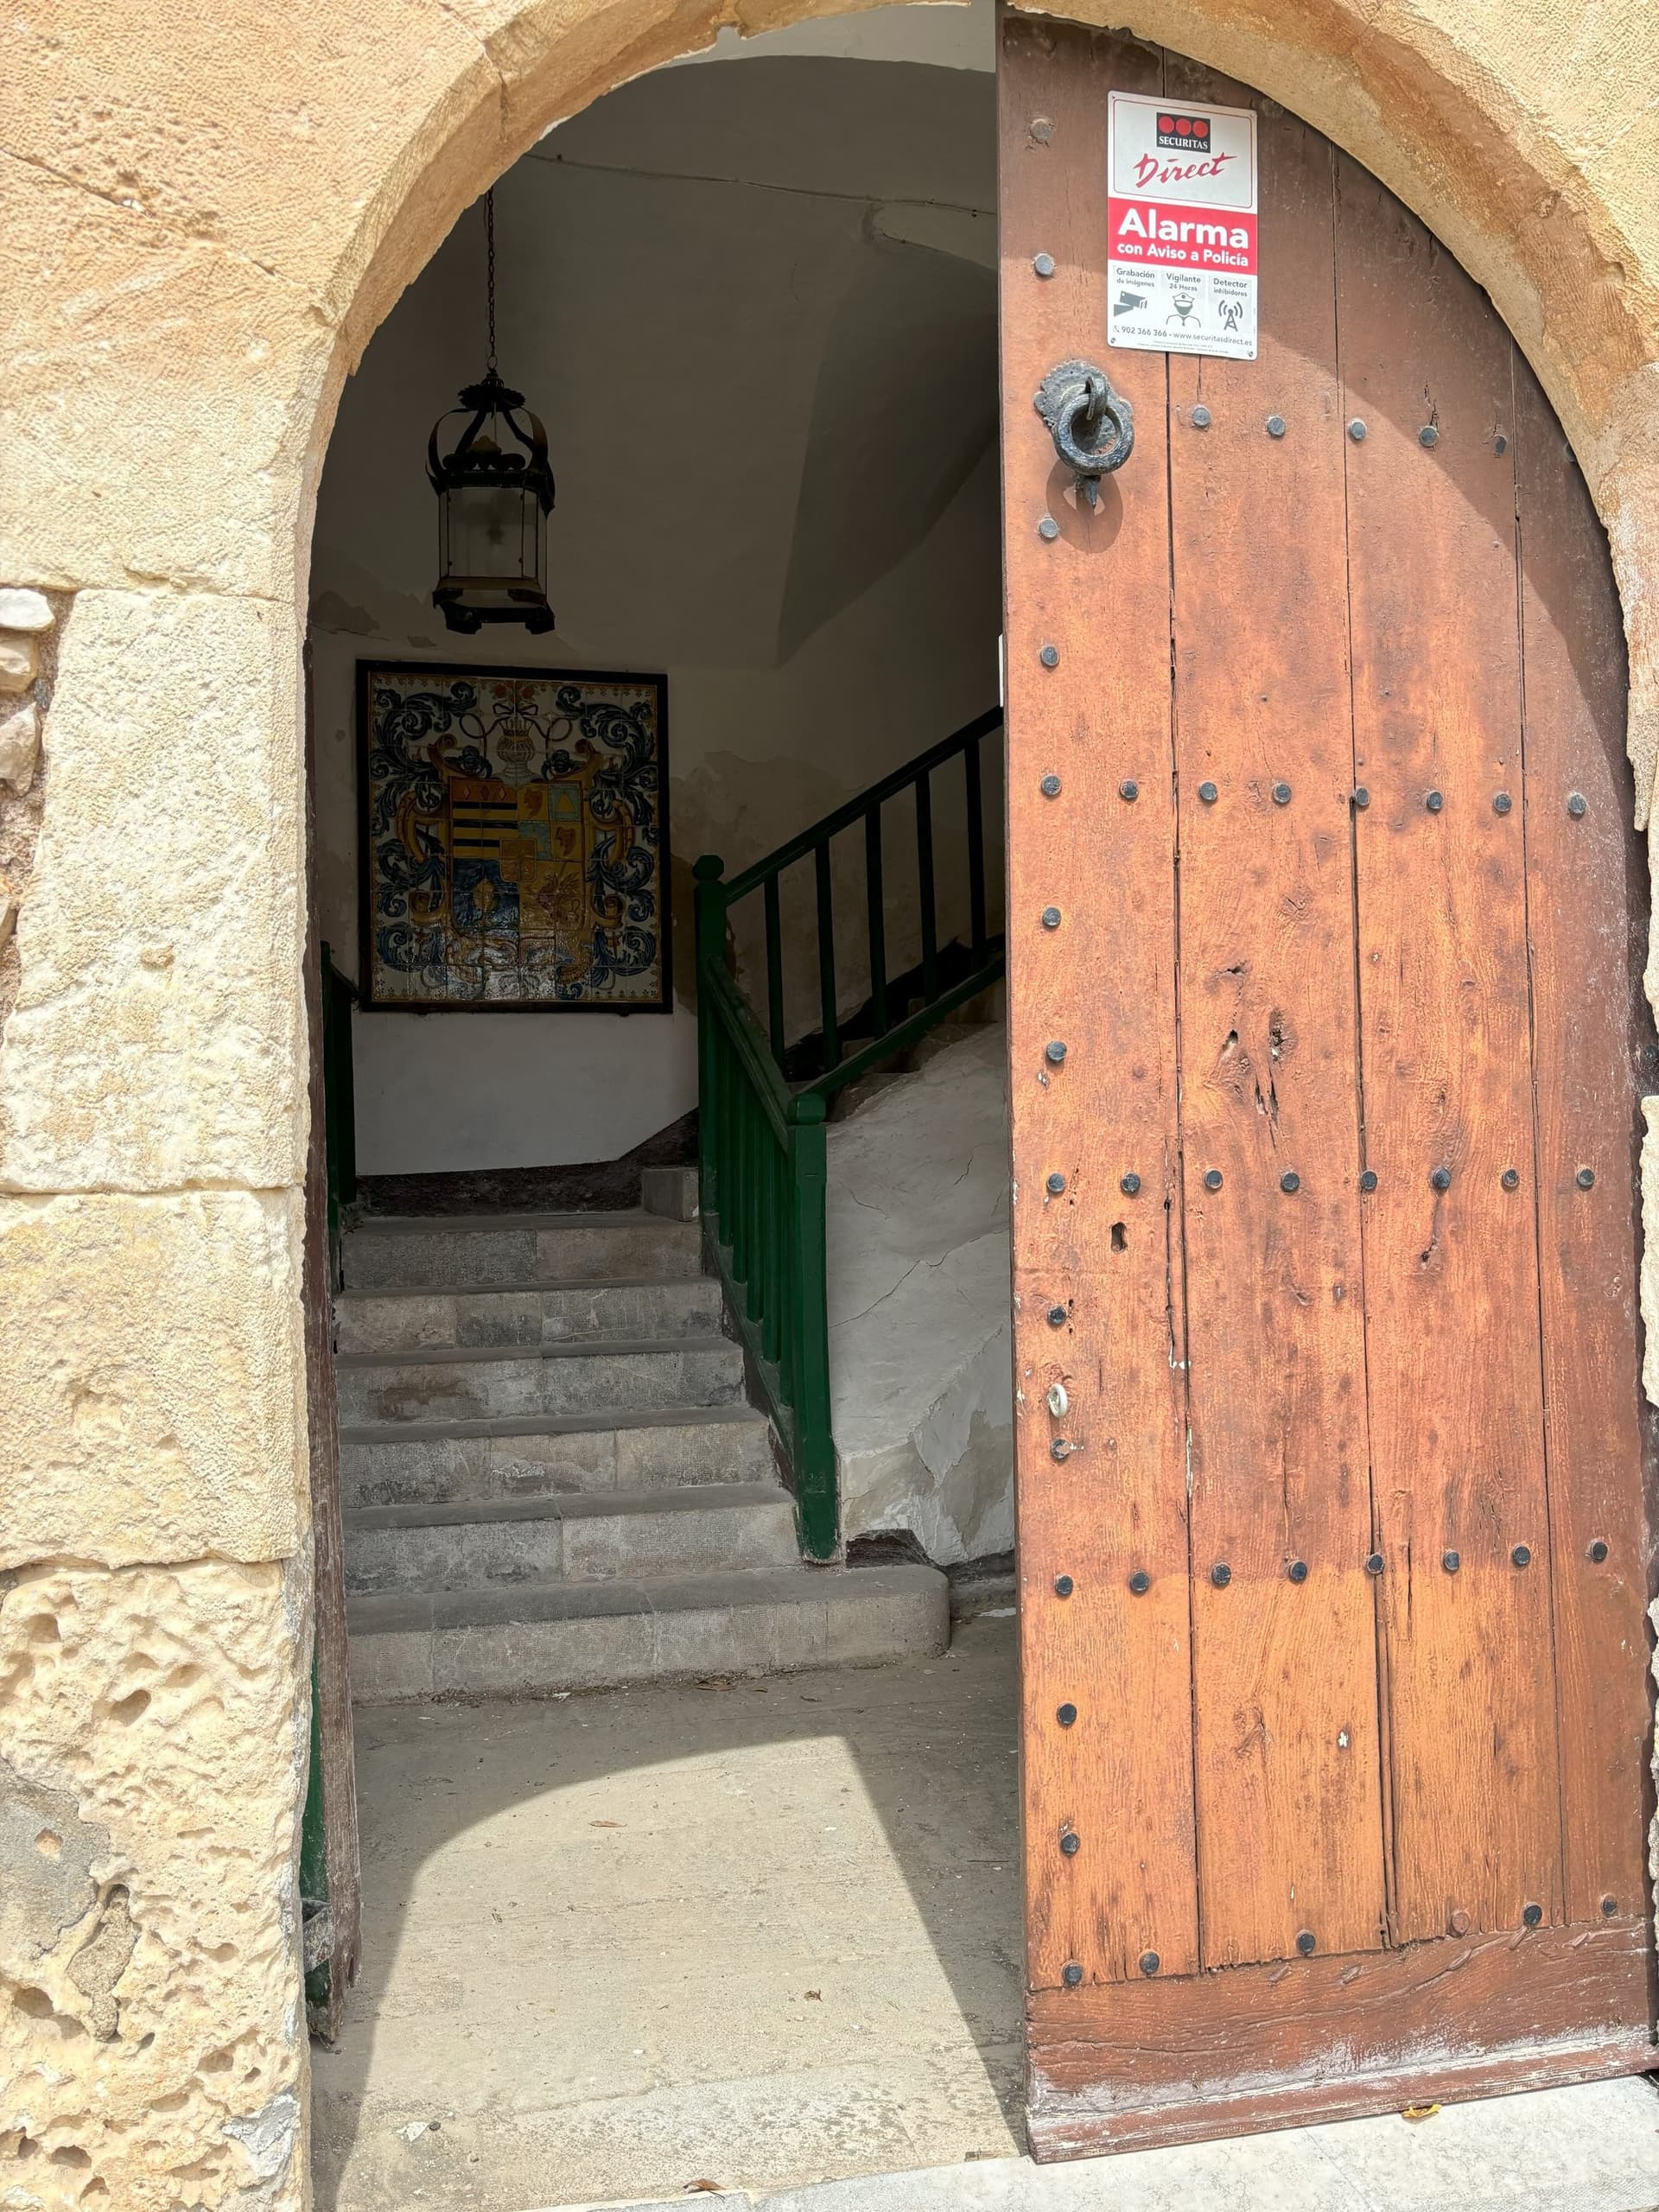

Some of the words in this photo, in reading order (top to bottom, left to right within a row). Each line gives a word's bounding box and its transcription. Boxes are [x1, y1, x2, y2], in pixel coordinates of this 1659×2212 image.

[1159, 136, 1208, 149] SECURITAS
[1134, 152, 1237, 188] Direct
[1118, 207, 1249, 249] Alarma
[1117, 243, 1142, 255] con
[1147, 244, 1186, 260] Aviso
[1191, 251, 1198, 261] a
[1203, 249, 1249, 267] Policía
[1116, 268, 1155, 278] Grabación
[1166, 272, 1201, 283] Vigilante
[1213, 277, 1248, 289] Detector
[1214, 288, 1248, 296] inhibidores
[1122, 326, 1135, 334] 902
[1137, 327, 1151, 336] 366
[1173, 333, 1253, 346] www.securitasdirect.es
